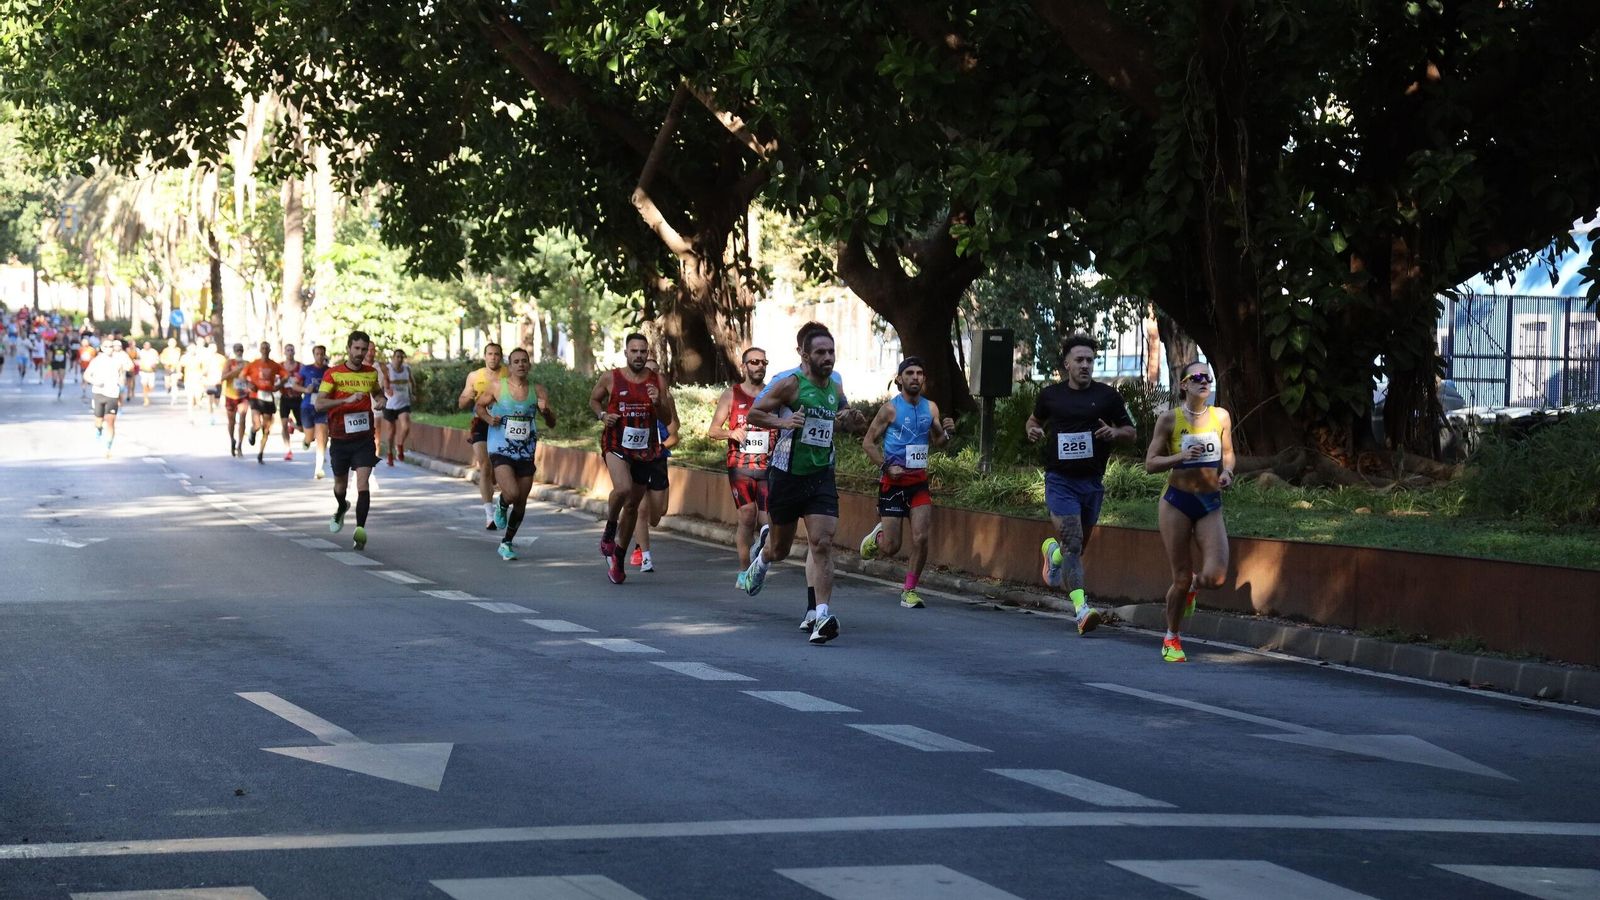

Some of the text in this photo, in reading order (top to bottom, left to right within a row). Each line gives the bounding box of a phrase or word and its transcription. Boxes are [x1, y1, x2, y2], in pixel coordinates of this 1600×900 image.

[348, 418, 368, 427] 1090
[509, 427, 527, 435] 203
[808, 427, 831, 439] 410
[627, 435, 645, 443] 787
[1062, 442, 1087, 451] 226
